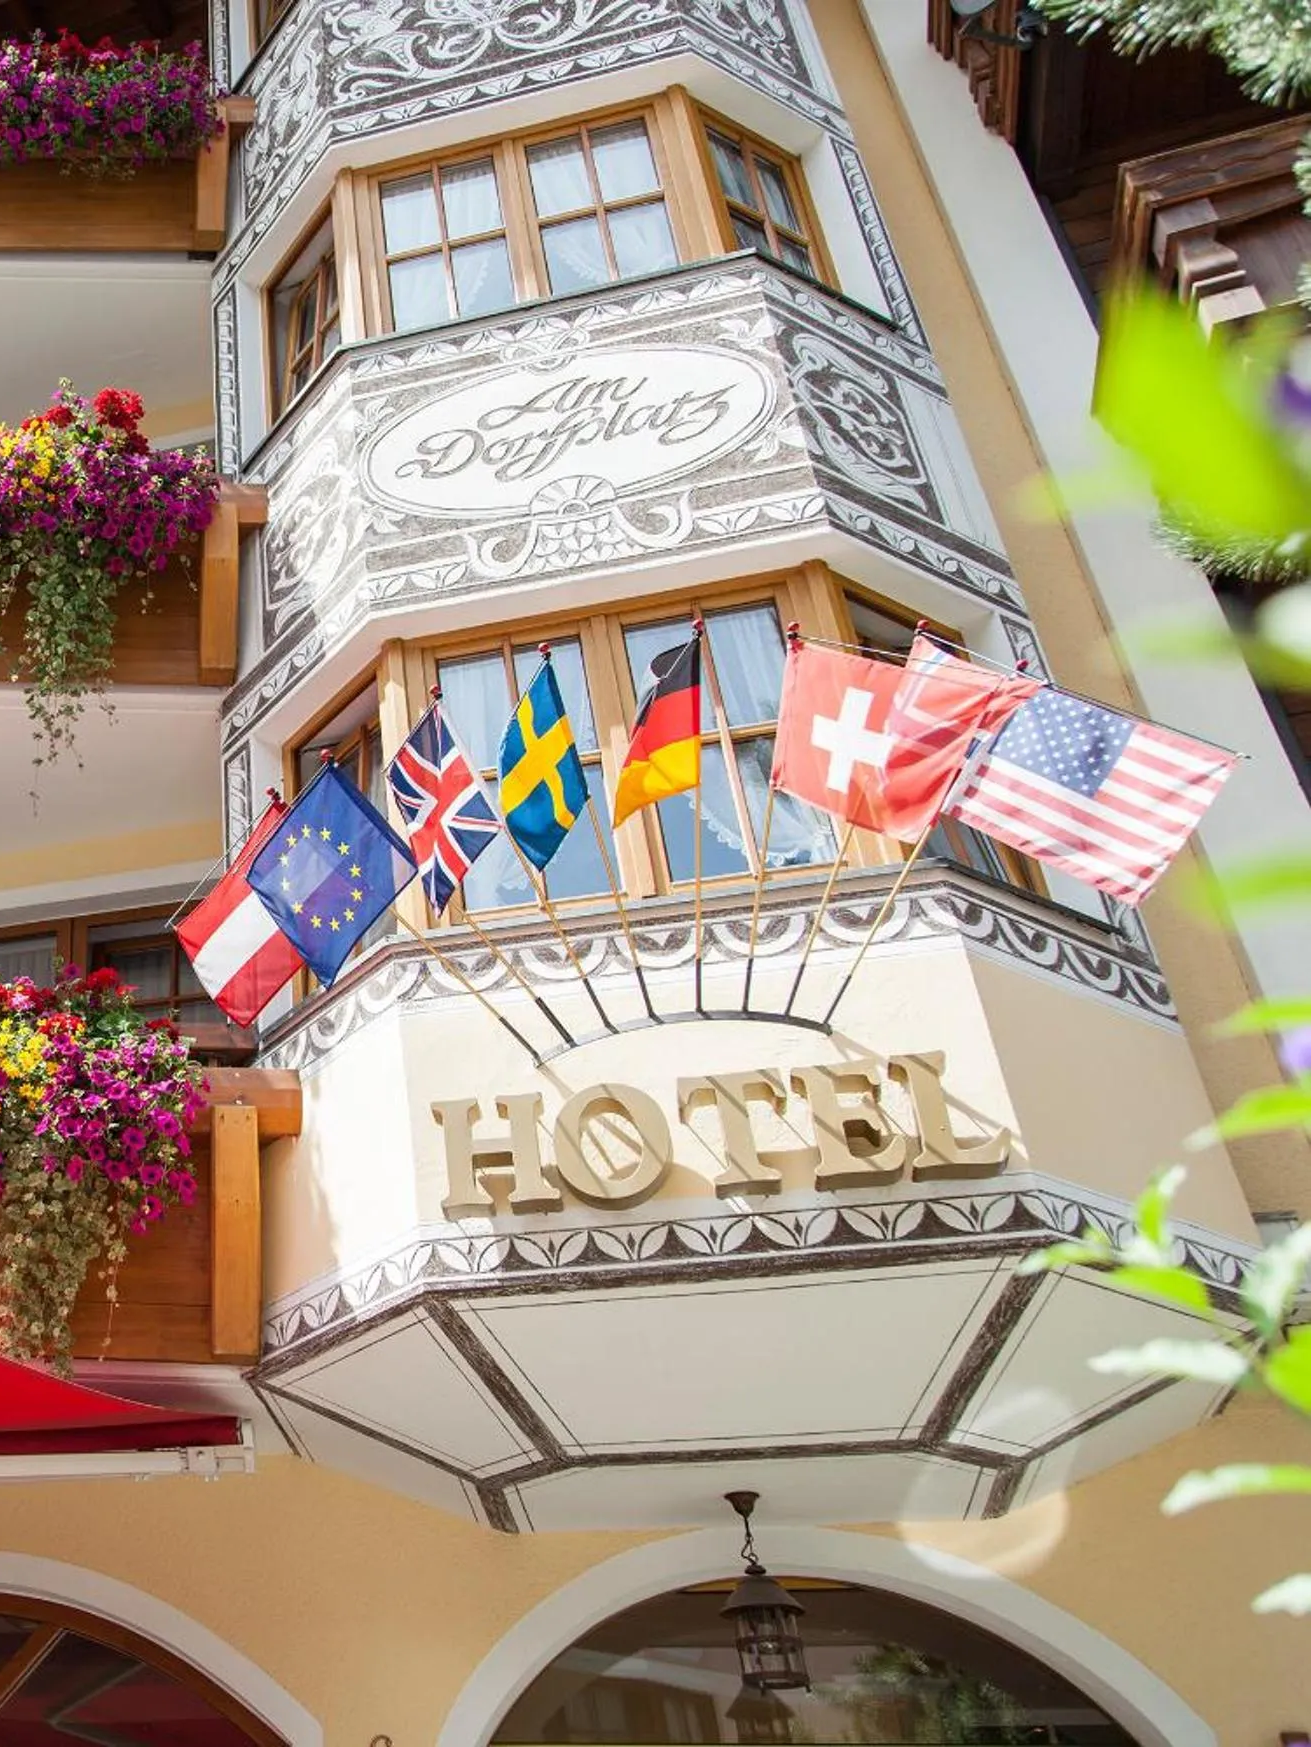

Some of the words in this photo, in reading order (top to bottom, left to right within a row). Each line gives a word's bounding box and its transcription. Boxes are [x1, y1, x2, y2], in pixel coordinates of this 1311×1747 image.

[394, 380, 742, 482] Dorfplatz
[477, 375, 648, 431] Am
[430, 1049, 1012, 1221] HOTEL
